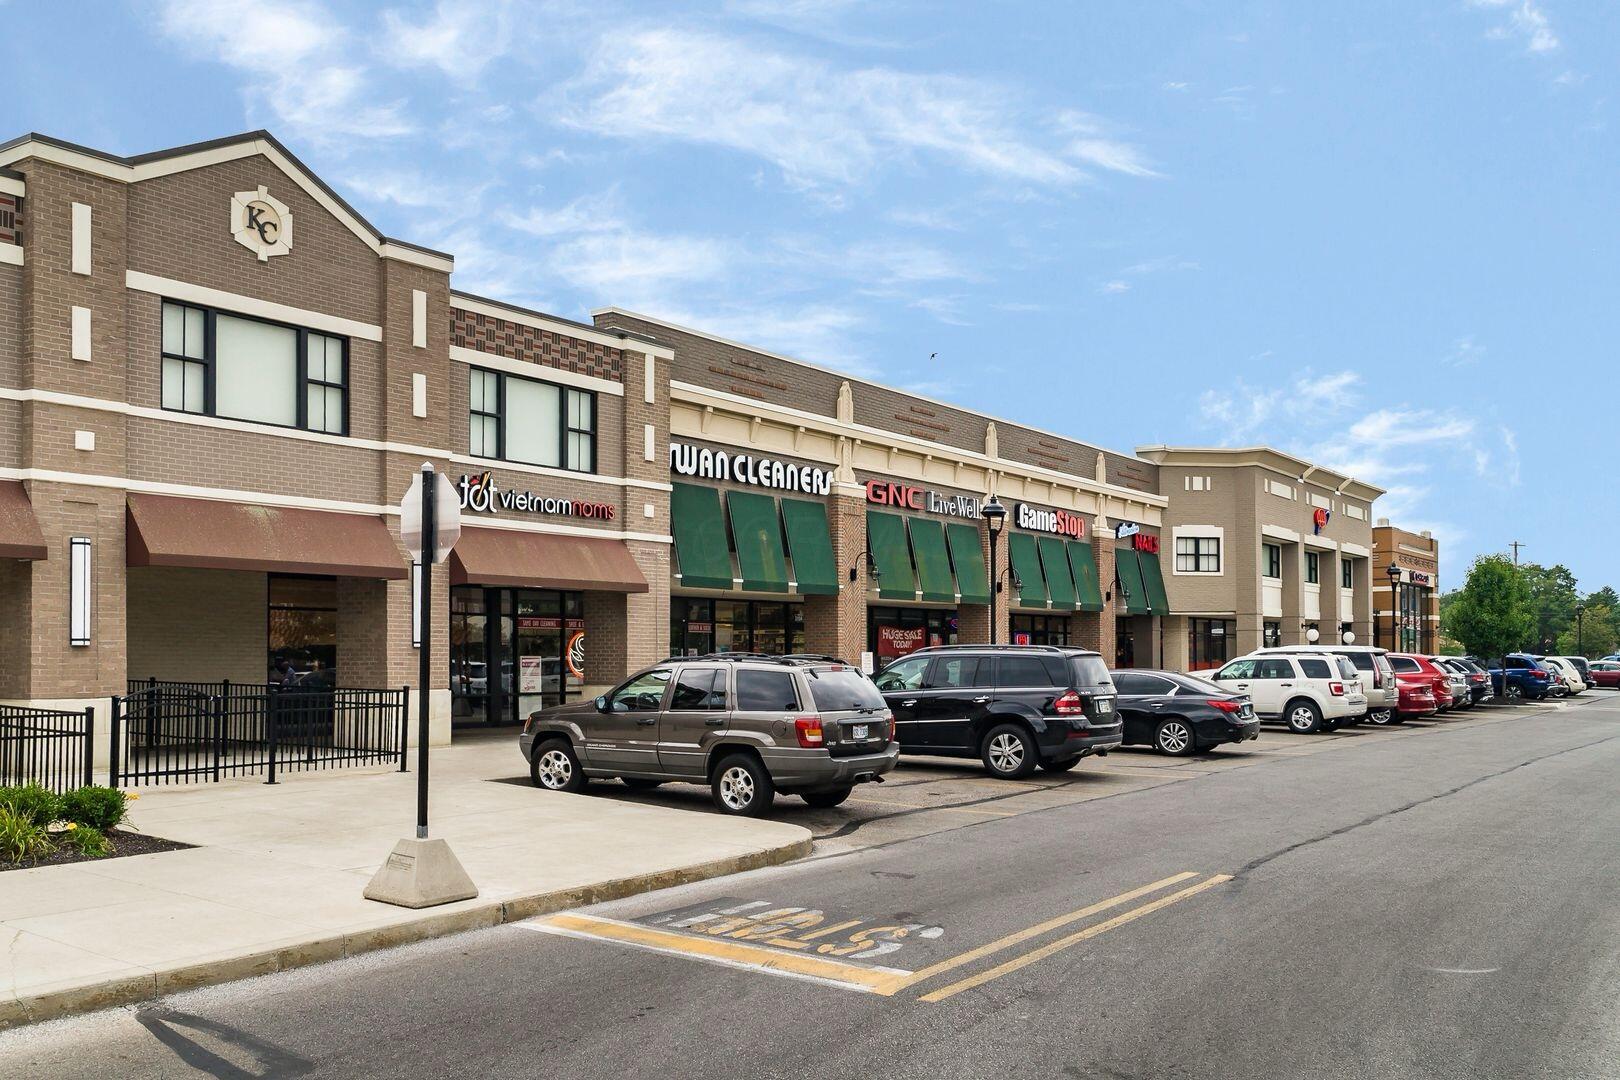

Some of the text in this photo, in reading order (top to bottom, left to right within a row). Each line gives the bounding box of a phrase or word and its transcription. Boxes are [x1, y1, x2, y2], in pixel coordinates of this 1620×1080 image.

[246, 205, 278, 246] KC
[733, 454, 835, 496] CLEANERS
[866, 479, 981, 520] GNC Live Well
[1018, 503, 1086, 540] GameStop
[1134, 533, 1160, 554] NAILS
[882, 628, 905, 640] HUGE
[905, 628, 923, 641] SALE
[893, 640, 914, 649] TODAY!
